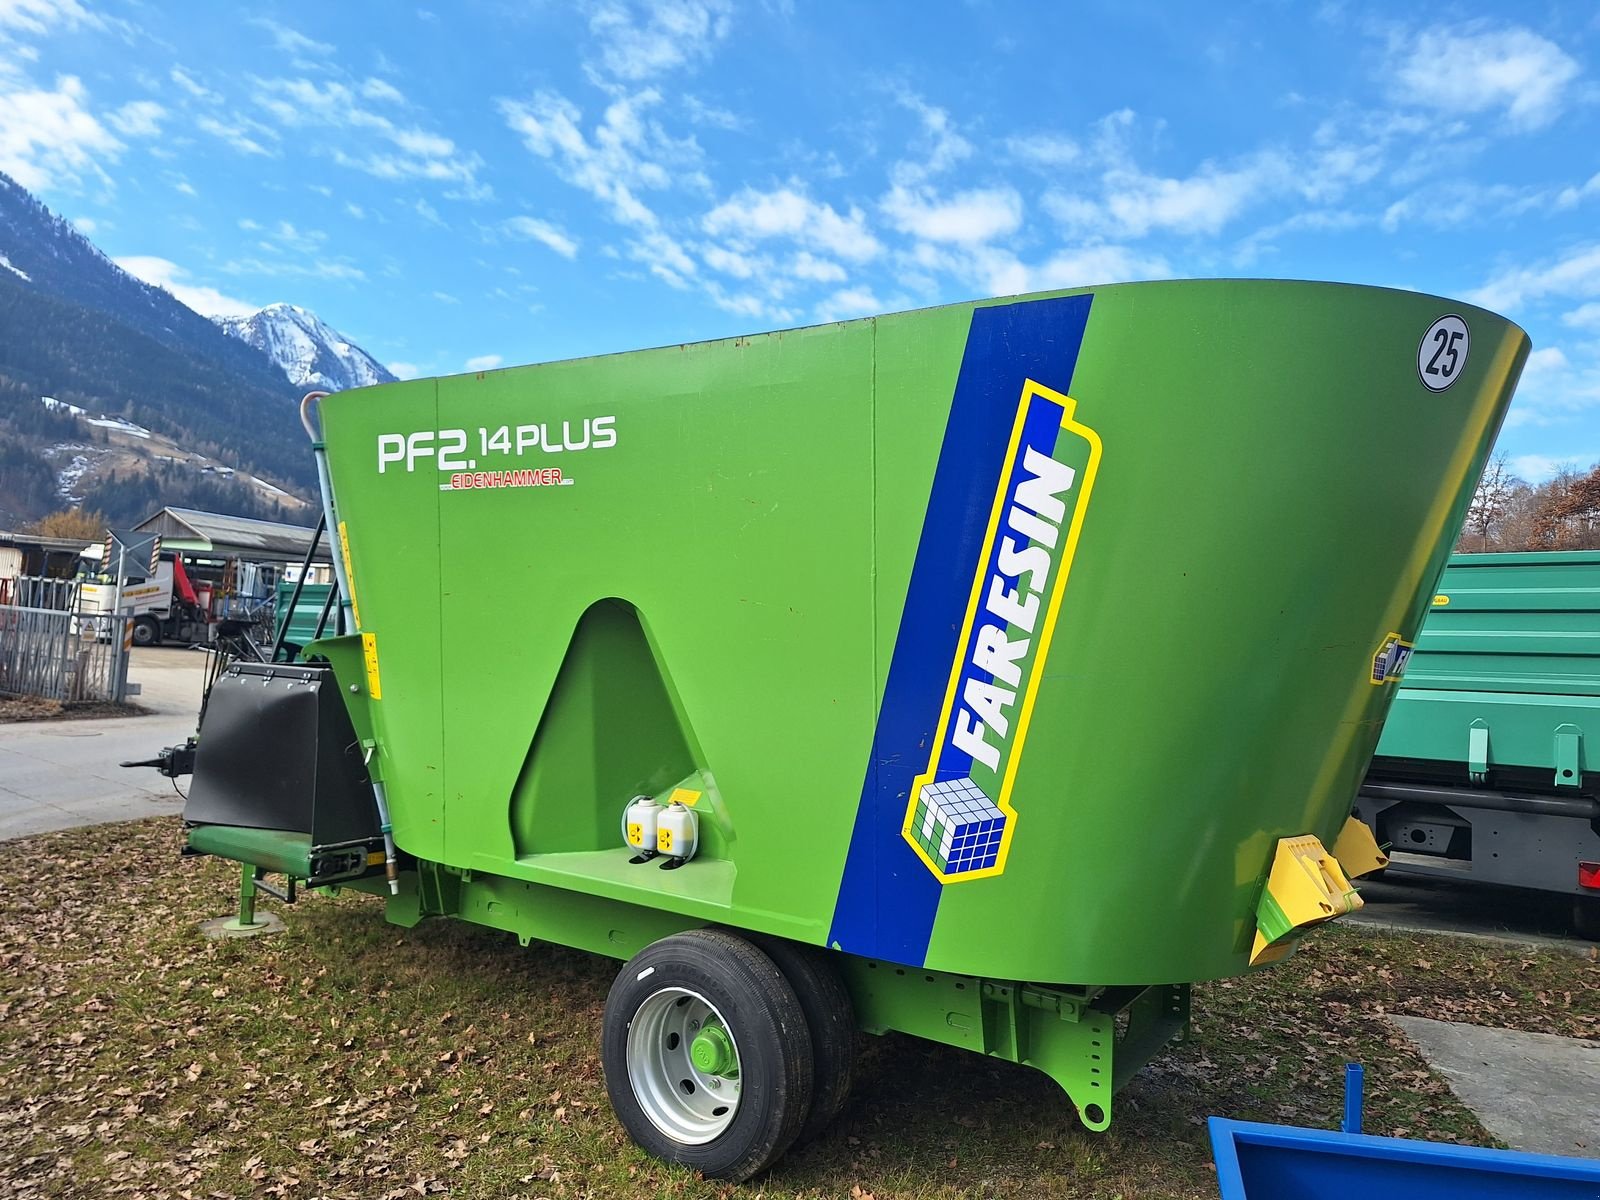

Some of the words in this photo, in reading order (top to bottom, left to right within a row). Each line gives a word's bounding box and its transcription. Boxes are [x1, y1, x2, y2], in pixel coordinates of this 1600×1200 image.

[1425, 328, 1464, 377] 25
[451, 468, 562, 490] EIDENHAMMER
[952, 444, 1076, 773] FARESIN
